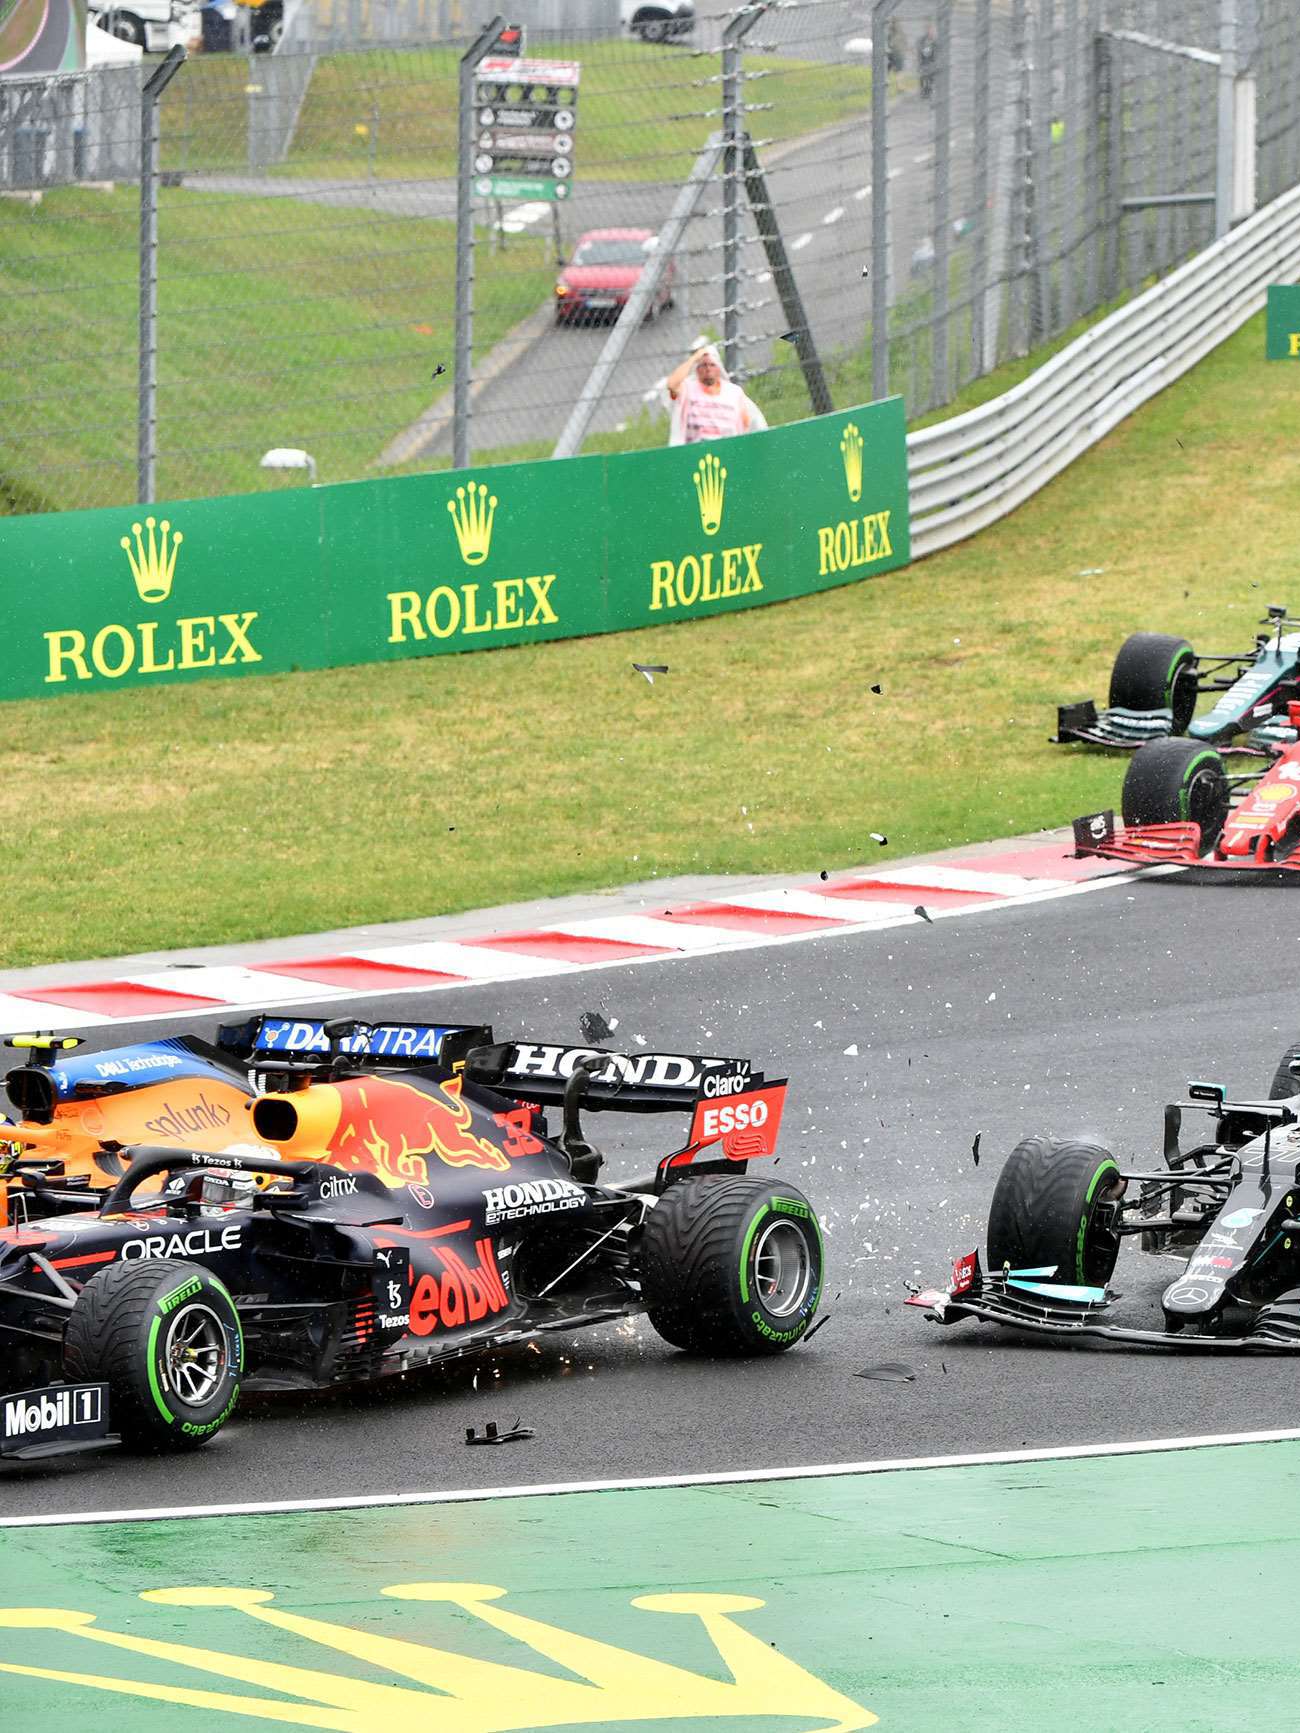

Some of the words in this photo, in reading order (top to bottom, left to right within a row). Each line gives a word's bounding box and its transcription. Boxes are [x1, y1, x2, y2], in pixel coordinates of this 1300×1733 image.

[817, 511, 892, 575] ROLEX
[649, 543, 764, 610] ROLEX
[387, 574, 559, 642] ROLEX
[43, 611, 263, 683] ROLEX
[703, 1074, 742, 1099] Claro
[703, 1100, 768, 1137] ESSO
[202, 1155, 232, 1167] Tezos
[319, 1173, 360, 1200] citrix
[482, 1179, 586, 1212] HONDA
[121, 1225, 242, 1262] ORACLE
[157, 1275, 203, 1315] PIRELLI
[379, 1313, 410, 1329] Tezos
[5, 1391, 70, 1438] Mobil
